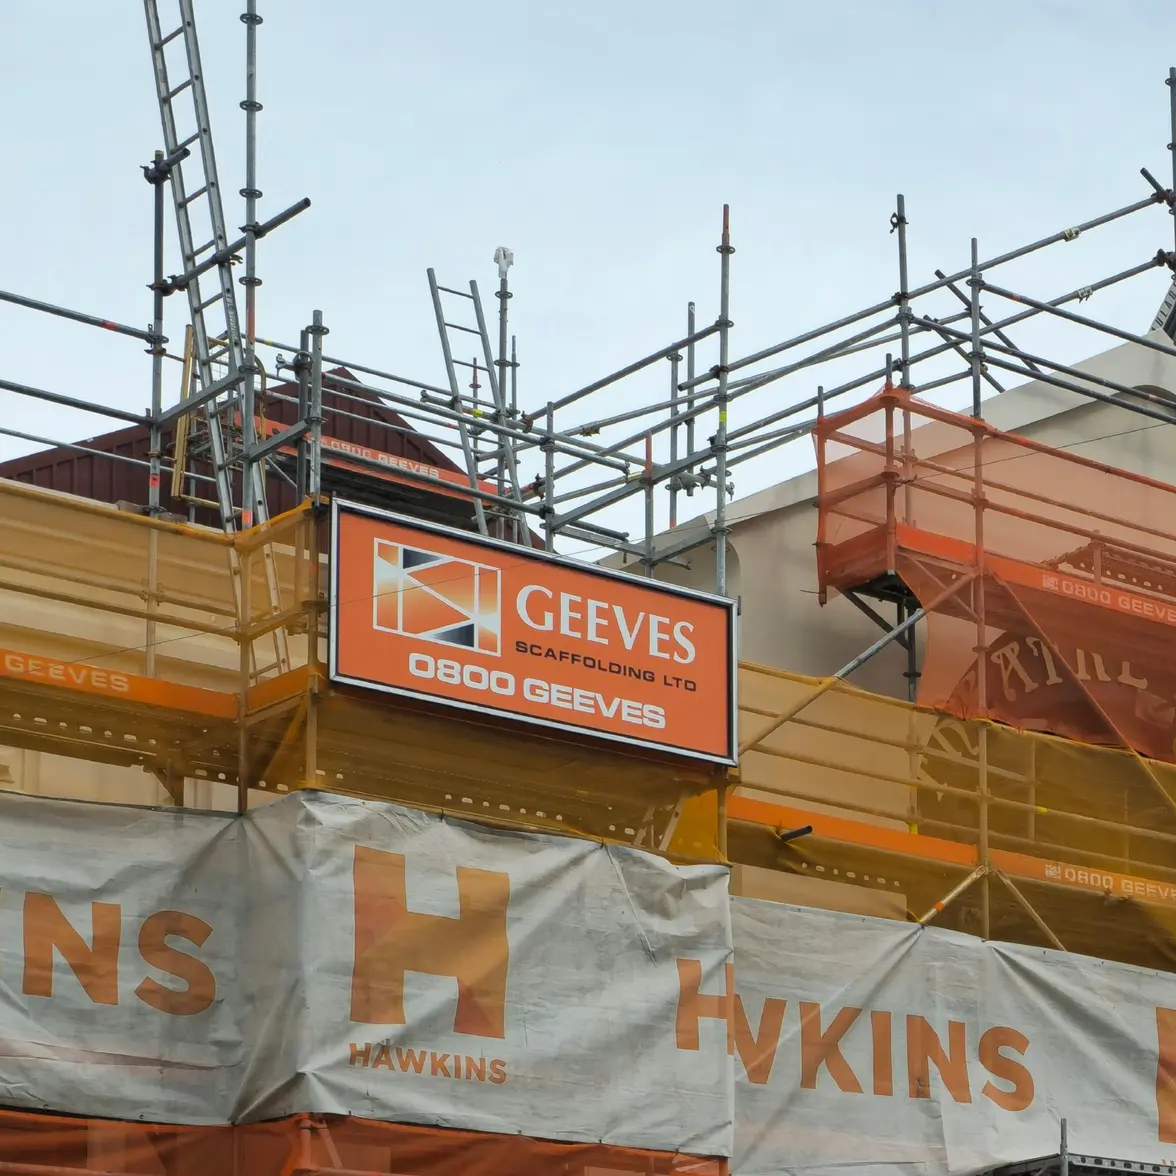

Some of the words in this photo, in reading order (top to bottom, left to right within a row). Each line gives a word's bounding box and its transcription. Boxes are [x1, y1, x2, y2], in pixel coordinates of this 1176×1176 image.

[1061, 581, 1111, 605] 0800
[516, 585, 696, 664] GEEVES
[4, 654, 129, 692] GEEVES
[408, 652, 516, 696] 0800
[523, 677, 665, 729] GEEVES
[515, 640, 655, 683] SCAFFOLDING
[663, 675, 697, 692] LTD
[350, 844, 511, 1040] H
[348, 1042, 508, 1085] HAWKINS
